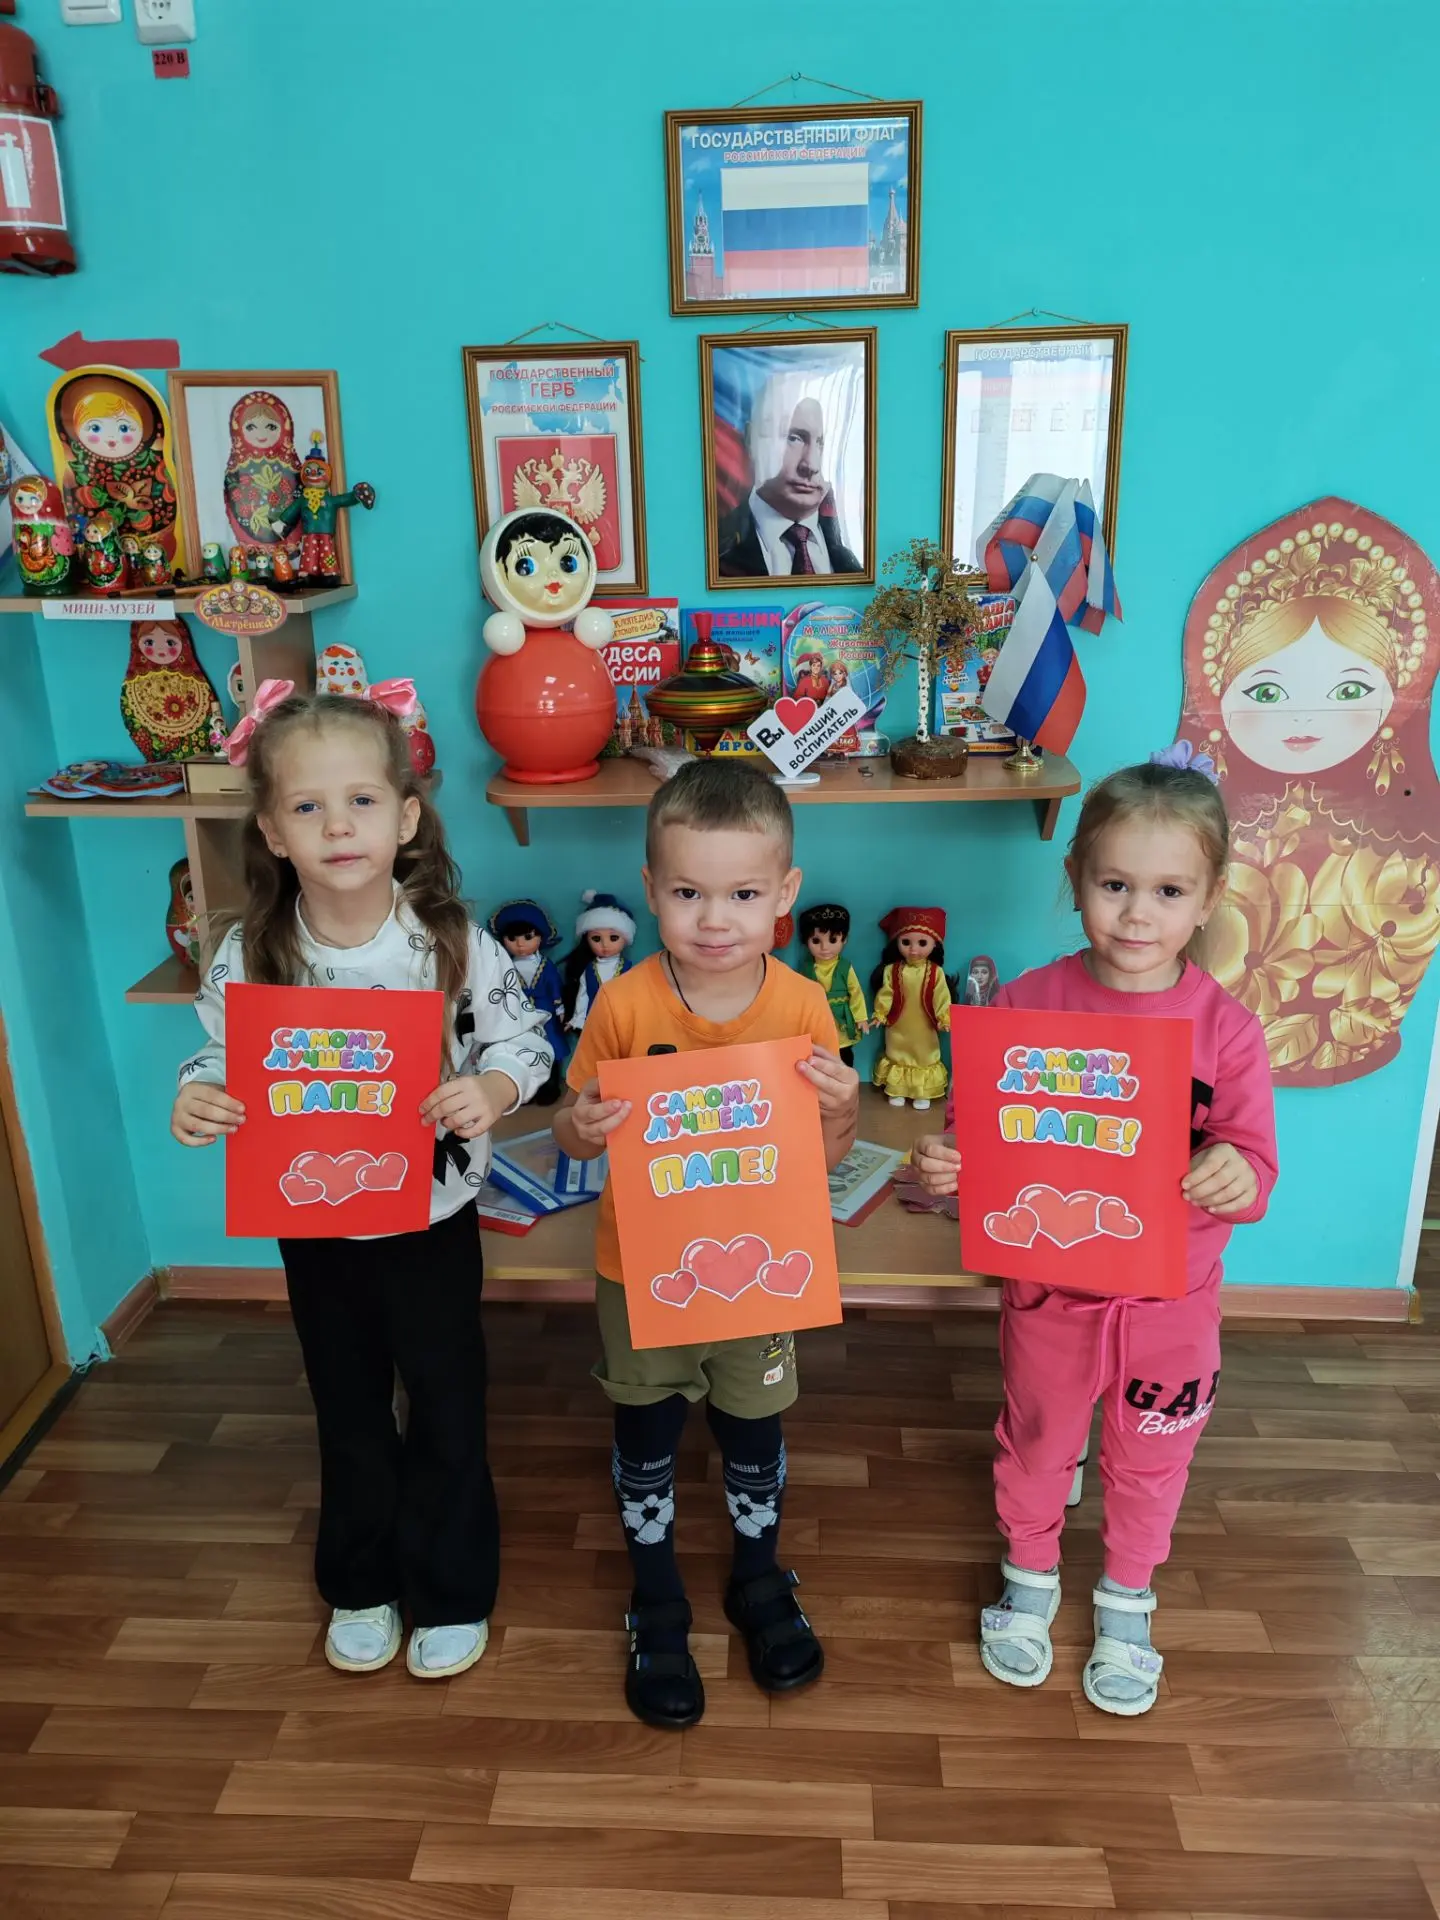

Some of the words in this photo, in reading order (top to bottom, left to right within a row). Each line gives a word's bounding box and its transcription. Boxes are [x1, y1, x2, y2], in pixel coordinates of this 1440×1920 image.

[154, 53, 173, 65] 220
[691, 127, 850, 149] ГОСУДАРСТВЕННЫЙ
[855, 126, 896, 141] ФЛАГ
[723, 147, 797, 163] РОССИЙСКОЙ
[799, 146, 866, 160] ФЕДЕРАЦИИ
[974, 342, 1094, 360] ГОСУДАРСТВЕННЫЙ
[489, 365, 614, 380] ГОСУДАРСТВЕННЫЙ
[530, 381, 575, 398] ГЕРБ
[492, 402, 556, 413] РОССИЙСКОЙ
[559, 401, 617, 412] ФЕДЕРАЦИИ
[61, 601, 156, 615] МИНИ-МУЗЕЙ
[982, 599, 1016, 615] АША
[613, 611, 654, 628] КЛОПЕДИЯ
[610, 665, 661, 682] ССИИ
[755, 726, 785, 749] Вы
[789, 707, 859, 770] ВОСПИТАТЕЛЬ
[794, 706, 838, 751] ЛУЧШИЙ
[273, 1029, 384, 1049] САМОМУ
[265, 1048, 391, 1071] ЛУЧШЕМУ
[1006, 1049, 1128, 1074] САМОМУ
[1000, 1070, 1137, 1098] ЛУЧШЕМУ
[270, 1081, 395, 1115] ПАПЕ!
[649, 1081, 758, 1116] САМОМУ
[645, 1101, 771, 1142] ЛУЧШЕМУ
[1001, 1107, 1139, 1155] ПАПЕ!
[650, 1146, 777, 1195] ПАПЕ!
